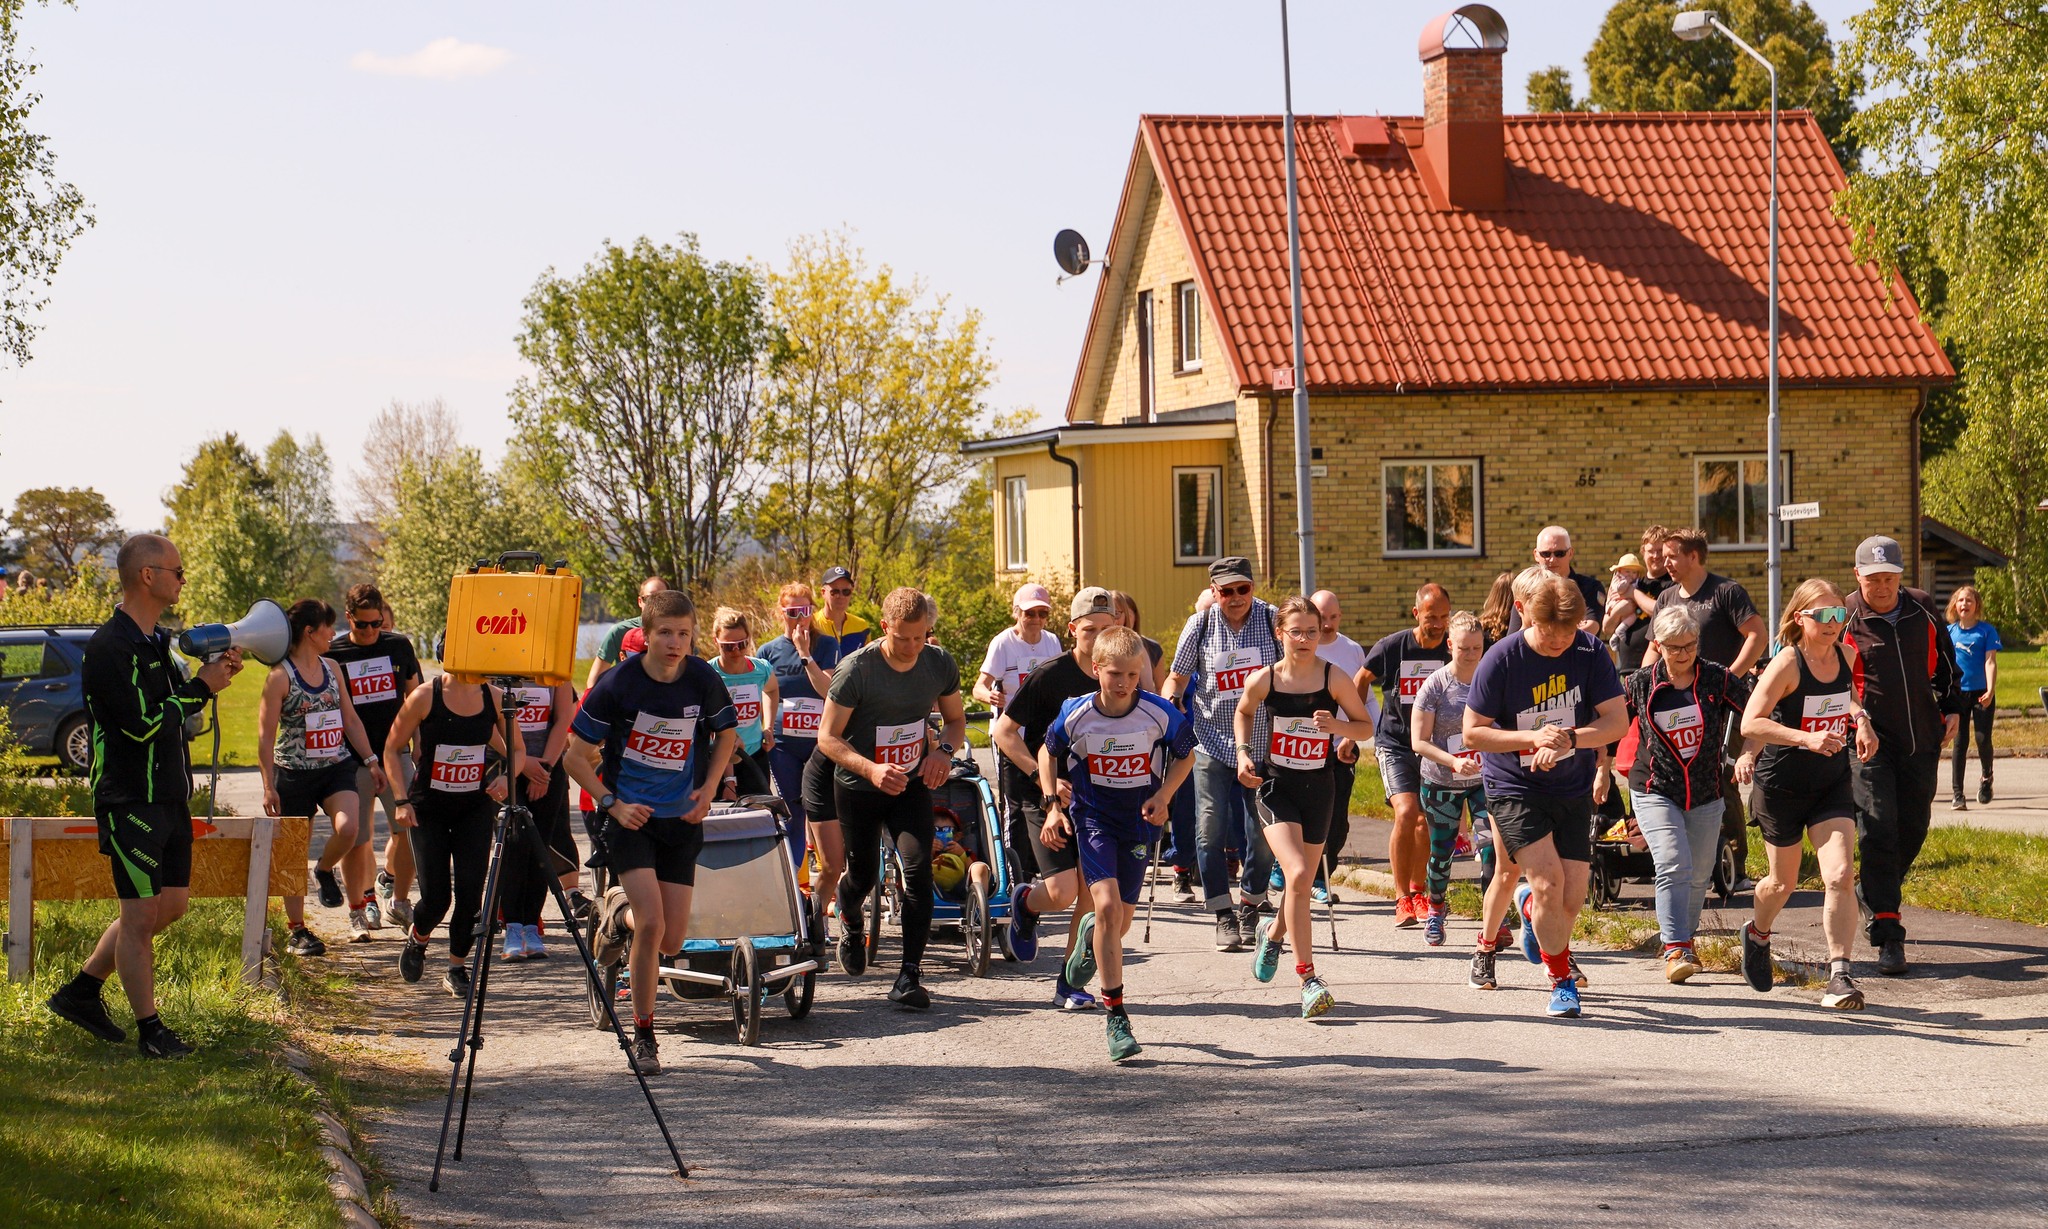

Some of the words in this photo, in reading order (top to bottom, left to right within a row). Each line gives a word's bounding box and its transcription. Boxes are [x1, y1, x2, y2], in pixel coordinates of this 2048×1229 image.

[355, 675, 393, 694] 1173
[1221, 668, 1259, 689] 117
[1404, 679, 1425, 694] 11
[1532, 682, 1546, 705] VI
[1547, 673, 1567, 698] ÄR
[516, 707, 545, 721] 237
[786, 714, 820, 728] 1194
[1807, 717, 1846, 735] 1246
[635, 735, 685, 758] 1243
[1277, 736, 1324, 758] 1104
[1666, 727, 1703, 748] 105
[881, 742, 920, 764] 1180
[437, 764, 480, 782] 1108
[1093, 757, 1146, 776] 1242
[126, 813, 153, 833] TRIMTEX
[130, 847, 159, 869] TRIMTEX
